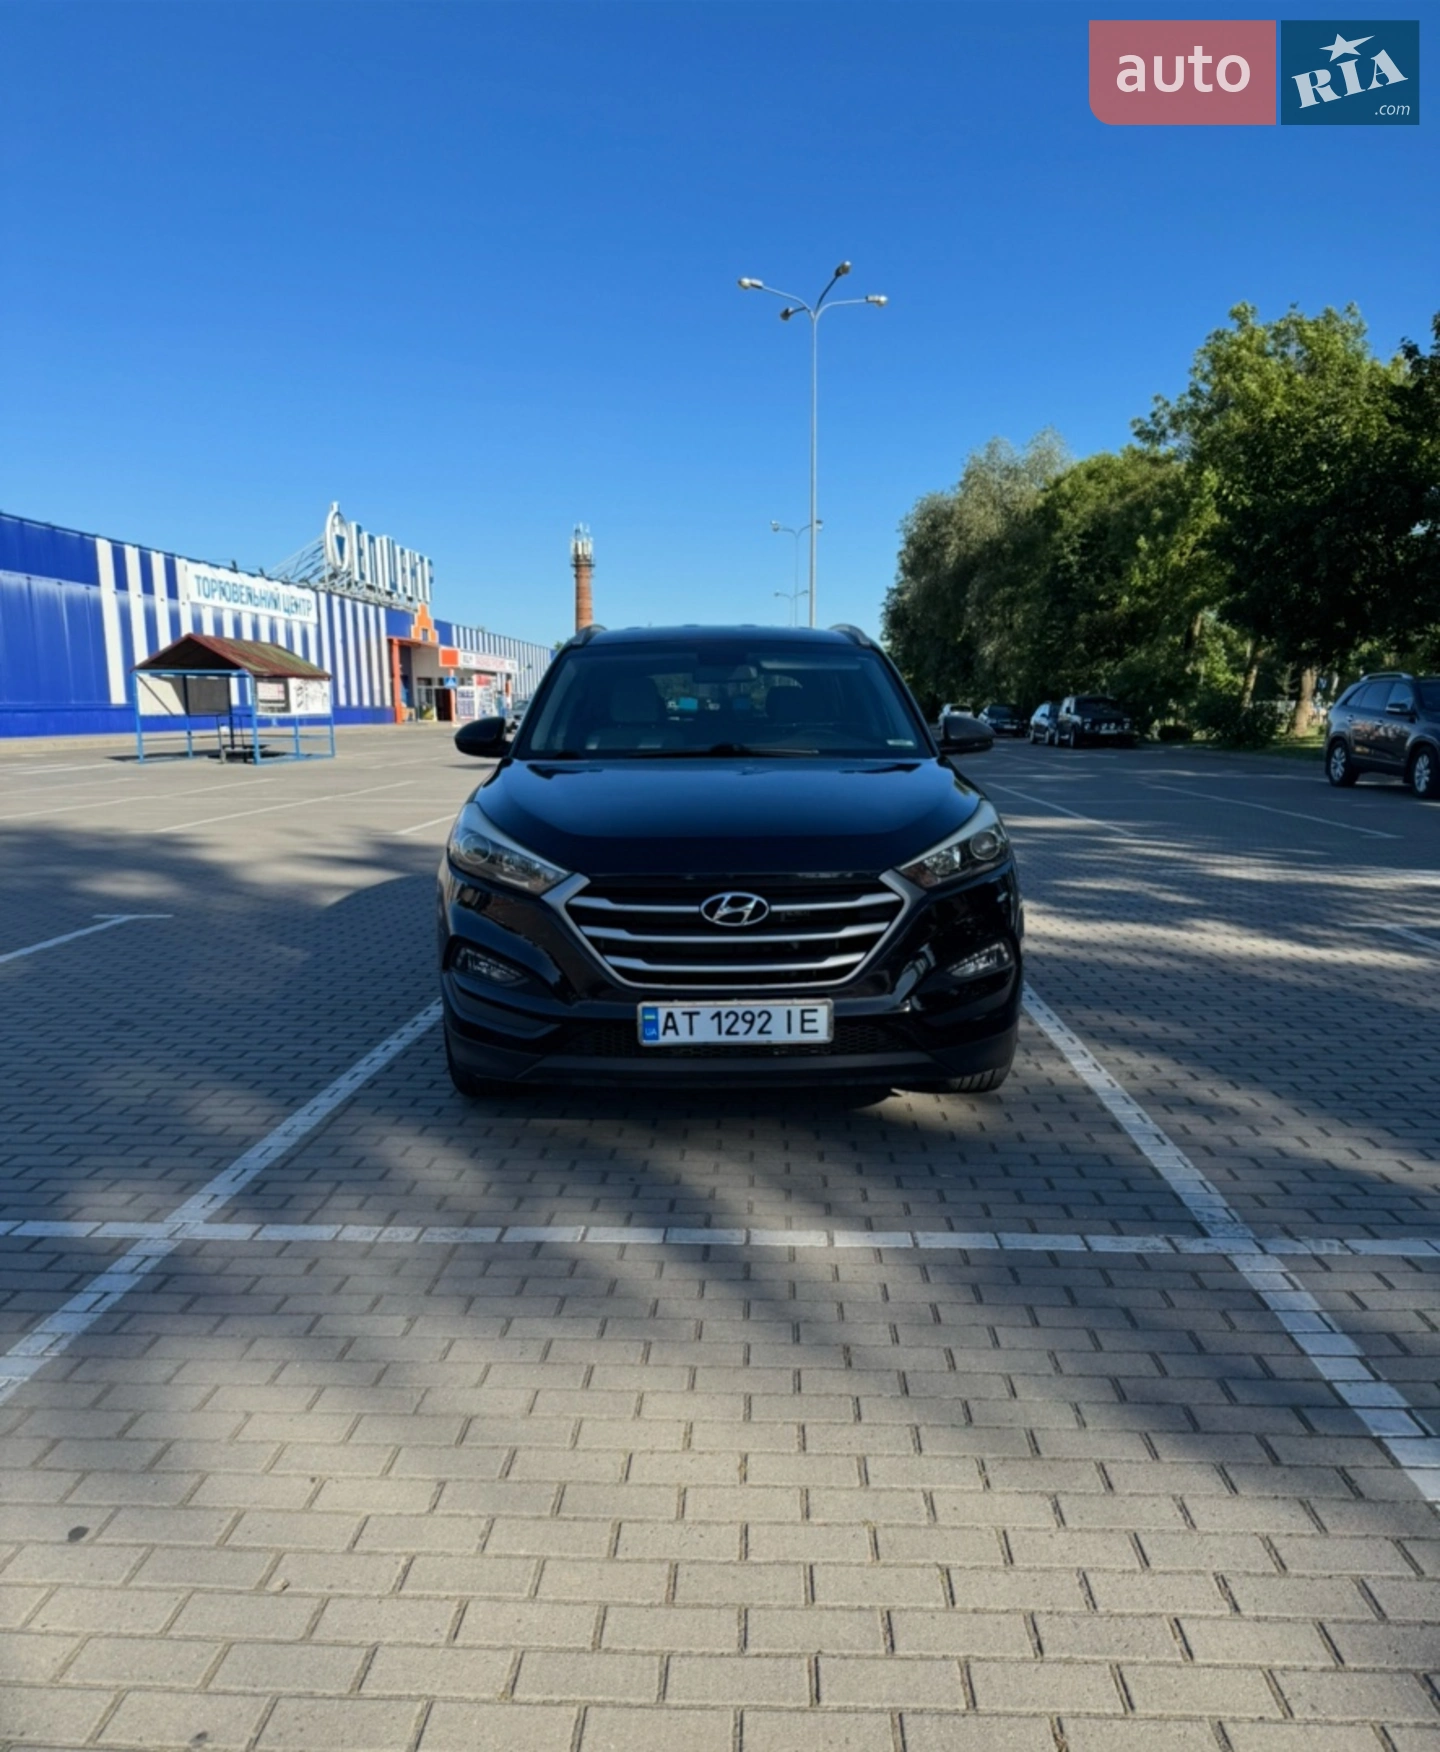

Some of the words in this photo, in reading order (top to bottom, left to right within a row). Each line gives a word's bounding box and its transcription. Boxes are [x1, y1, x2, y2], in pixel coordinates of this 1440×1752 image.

[194, 574, 281, 612] ТОРГОВЕЛЬНИЙ
[282, 593, 314, 617] ЦЕНТР
[645, 1028, 657, 1036] UA
[661, 1011, 701, 1036] AT
[710, 1010, 773, 1036] 1292
[786, 1008, 819, 1034] IE
